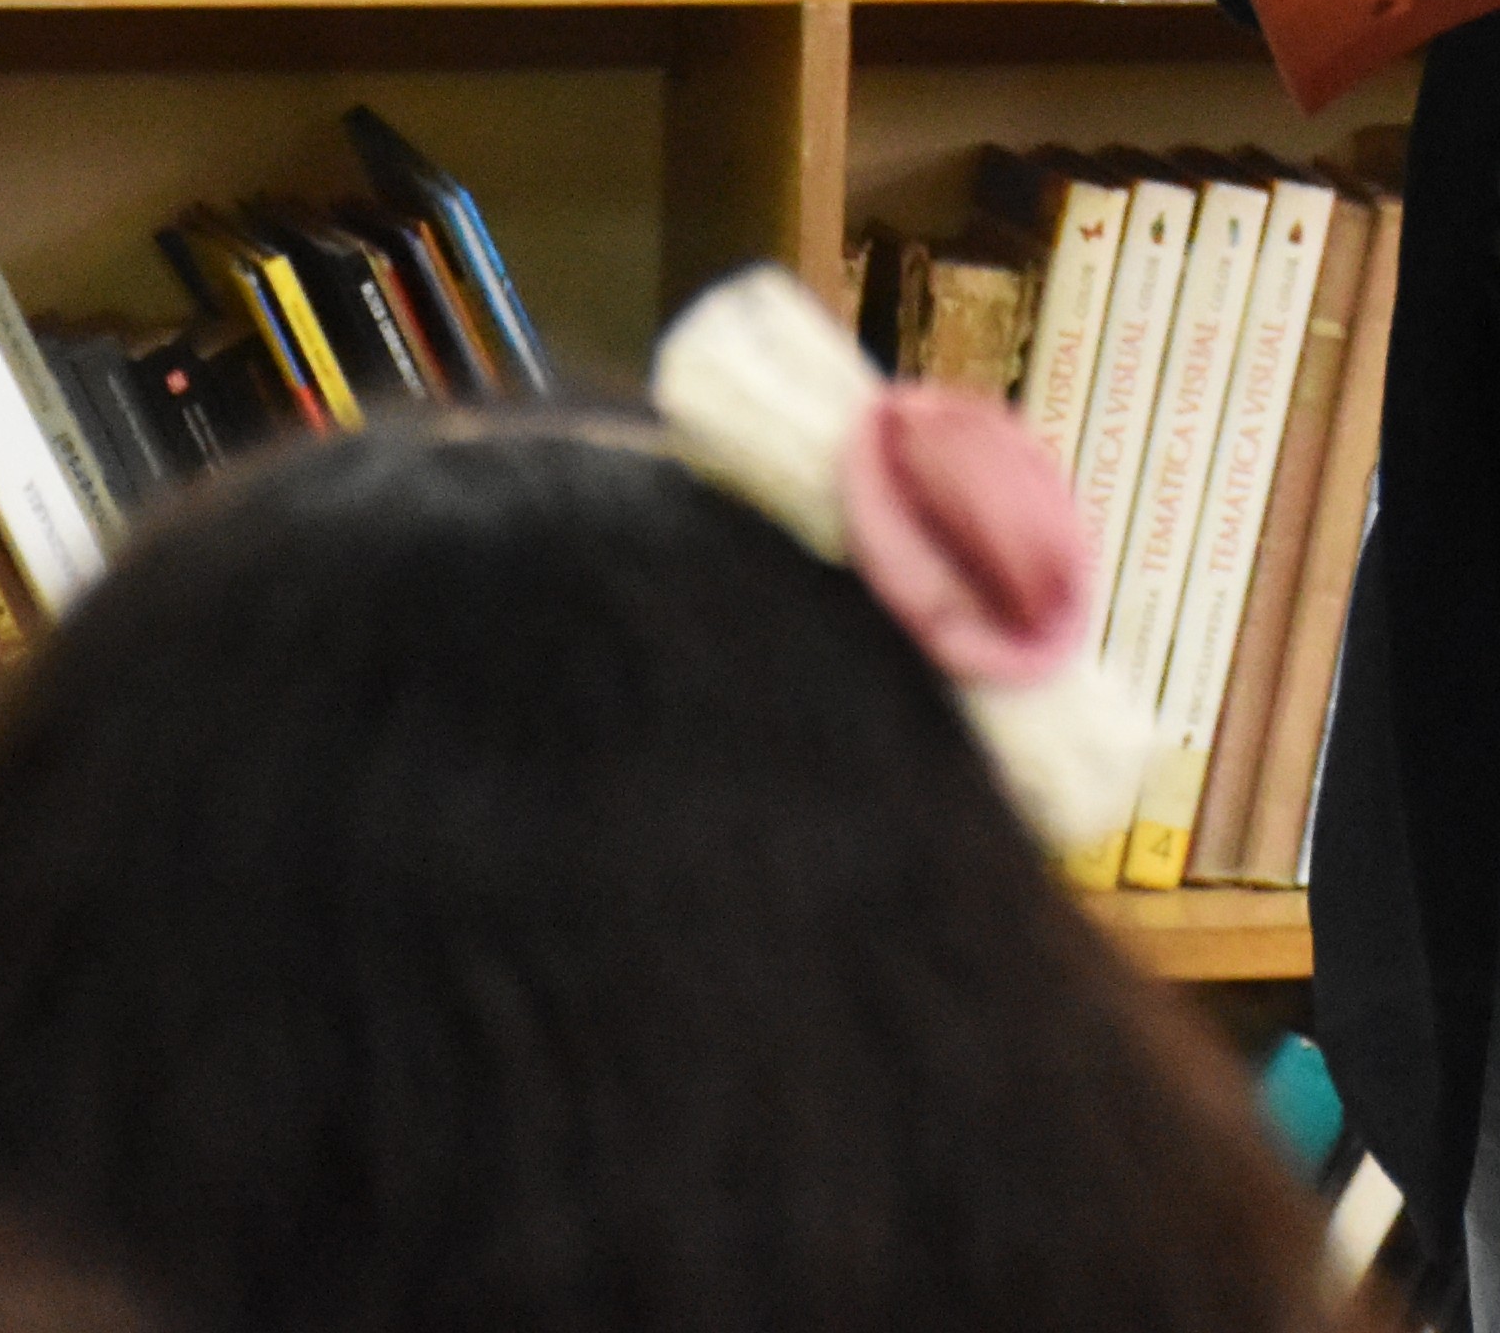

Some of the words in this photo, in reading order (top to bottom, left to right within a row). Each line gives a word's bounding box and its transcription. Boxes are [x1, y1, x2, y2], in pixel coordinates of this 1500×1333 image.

[1043, 324, 1085, 426] VISUAL
[1102, 314, 1151, 418] VISUAL
[1173, 315, 1222, 419] VISUAL
[1241, 316, 1290, 418] VISUAL
